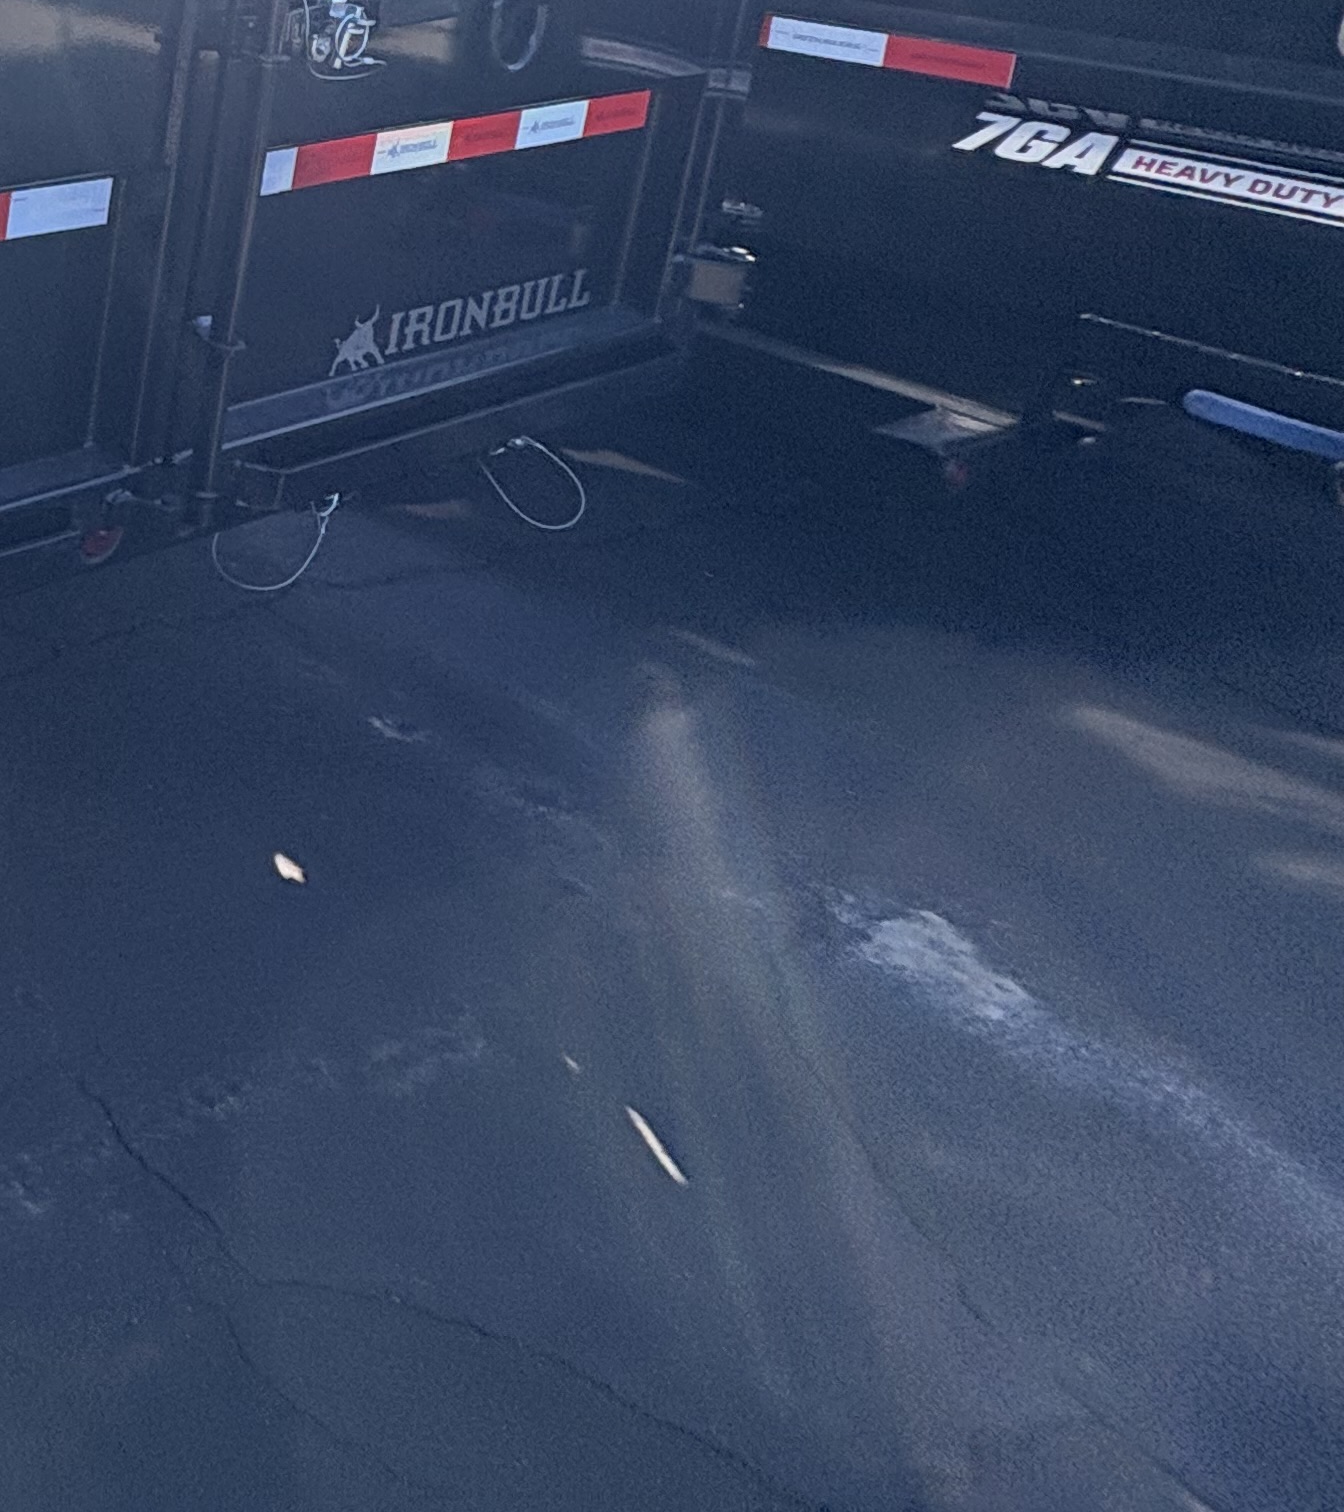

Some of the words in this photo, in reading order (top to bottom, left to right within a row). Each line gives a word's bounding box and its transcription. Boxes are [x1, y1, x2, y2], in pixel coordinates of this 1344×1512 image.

[951, 111, 1119, 176] 7GA
[1131, 155, 1245, 189] HEAVY
[1247, 178, 1344, 209] DUTY
[385, 268, 591, 355] IRONBULL
